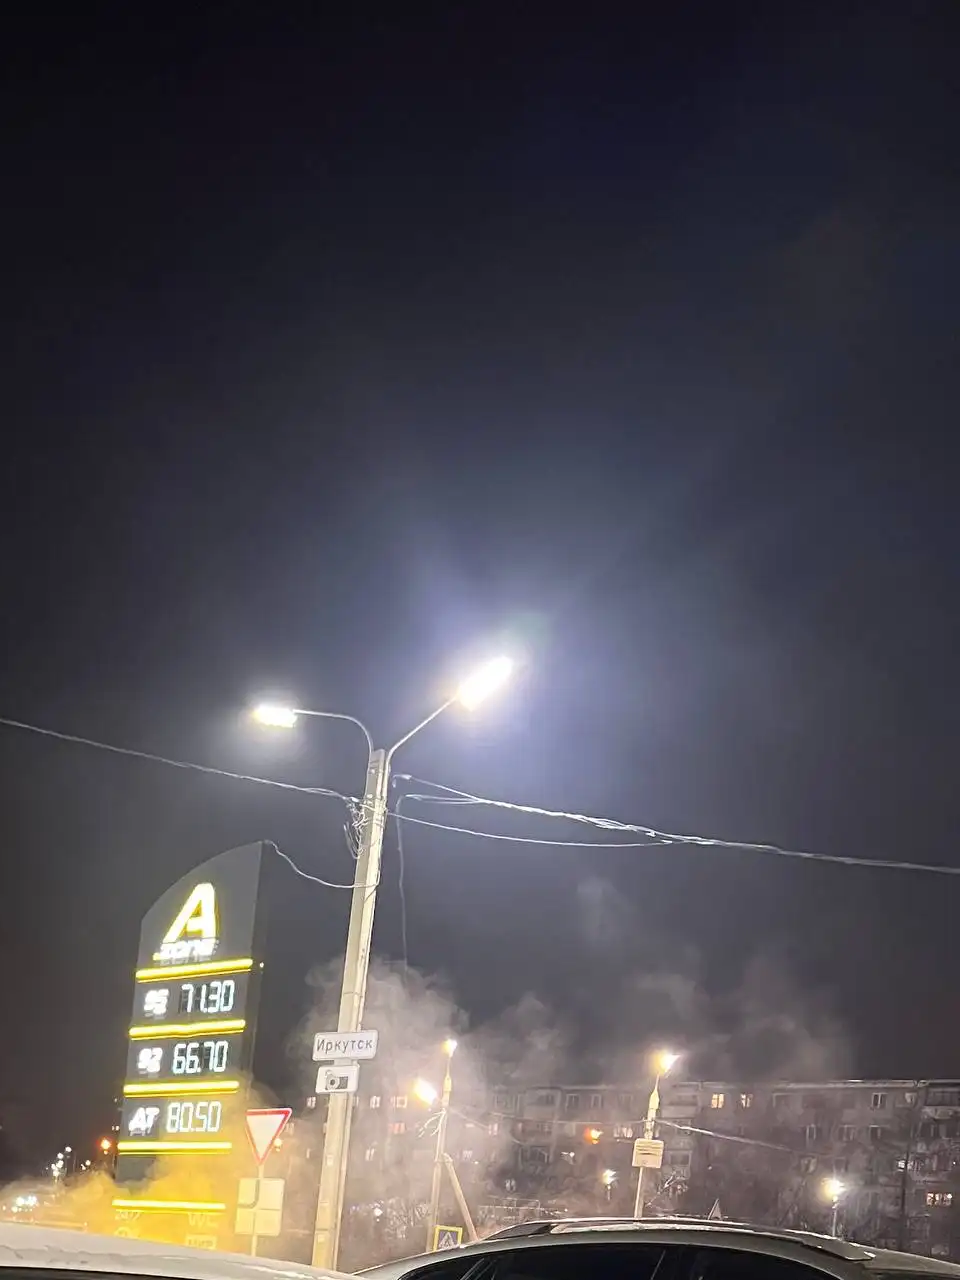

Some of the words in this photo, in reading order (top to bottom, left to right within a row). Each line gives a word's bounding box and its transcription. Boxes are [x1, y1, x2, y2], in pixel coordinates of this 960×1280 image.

[172, 1040, 229, 1074] 66.70
[316, 1038, 373, 1055] Иркутск
[166, 1101, 221, 1133] 80.50
